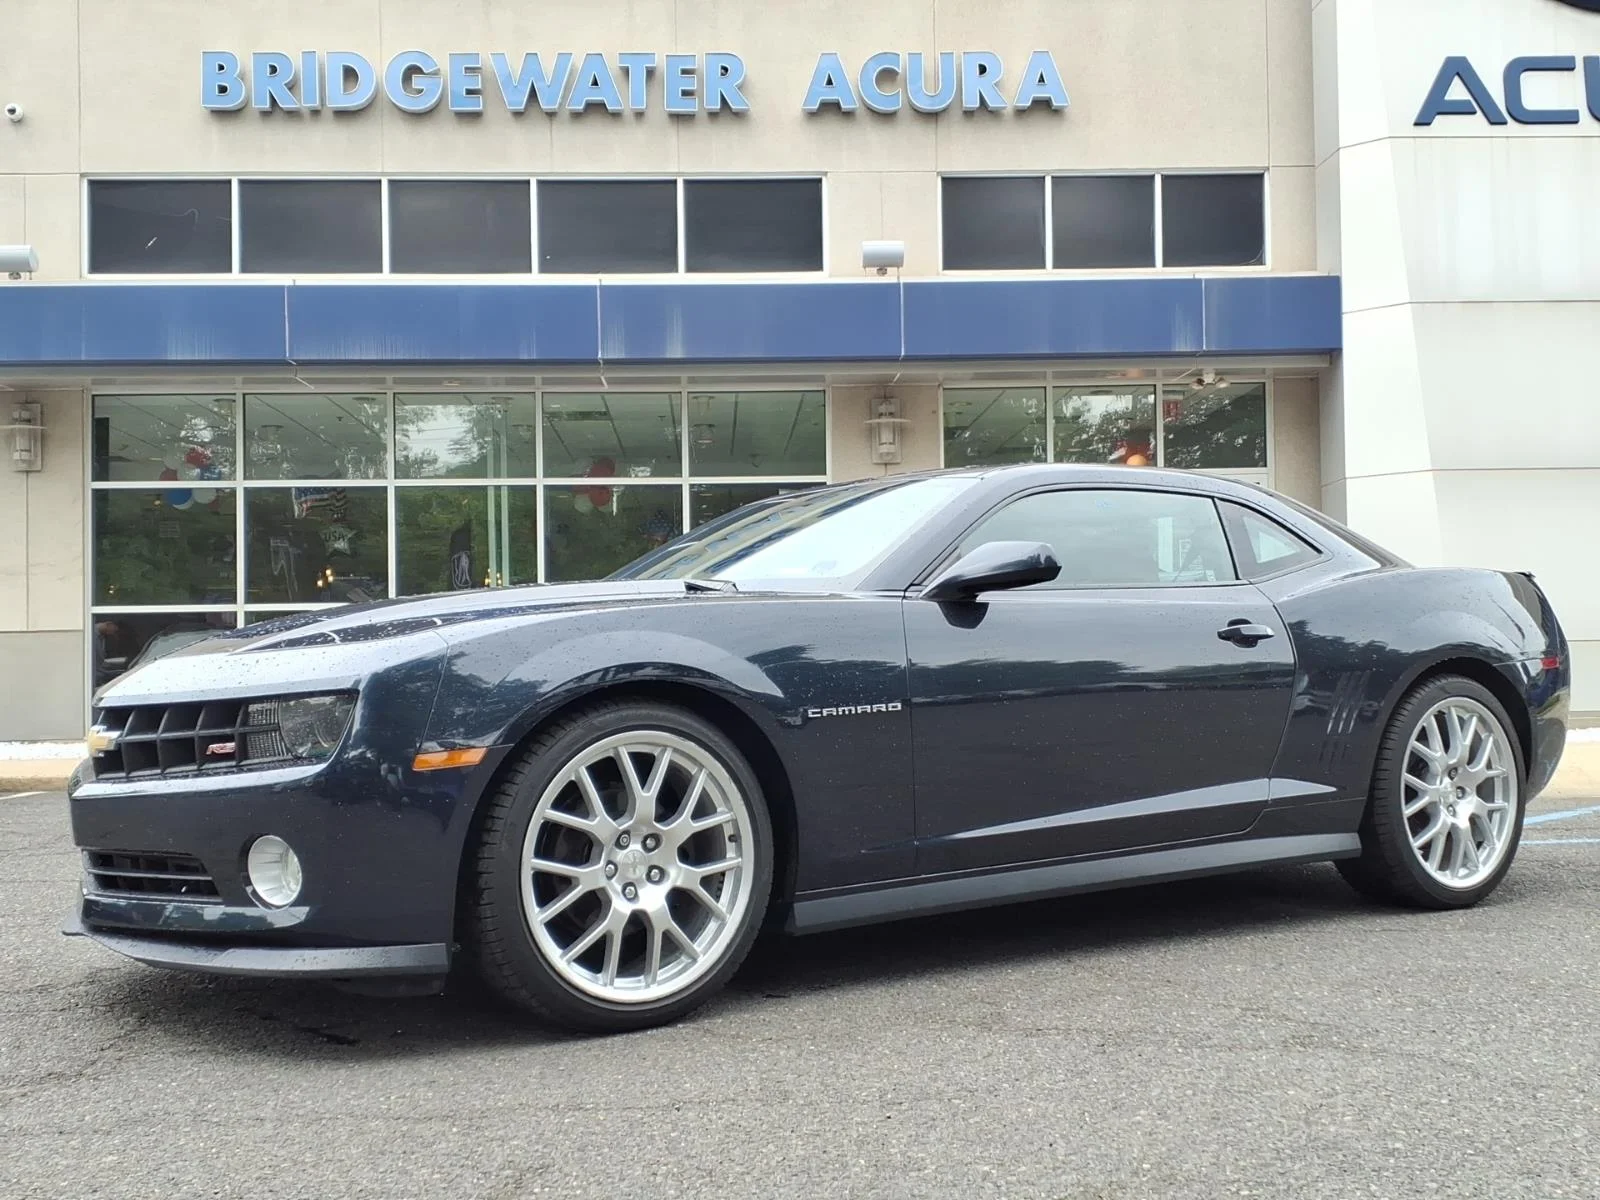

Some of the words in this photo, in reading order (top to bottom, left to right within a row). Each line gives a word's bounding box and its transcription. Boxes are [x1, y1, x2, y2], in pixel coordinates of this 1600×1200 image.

[201, 49, 750, 114] BRIDGEWATER
[802, 49, 1071, 114] ACURA
[1413, 55, 1600, 126] AC
[807, 702, 903, 718] CAMARO
[206, 742, 236, 755] RS
